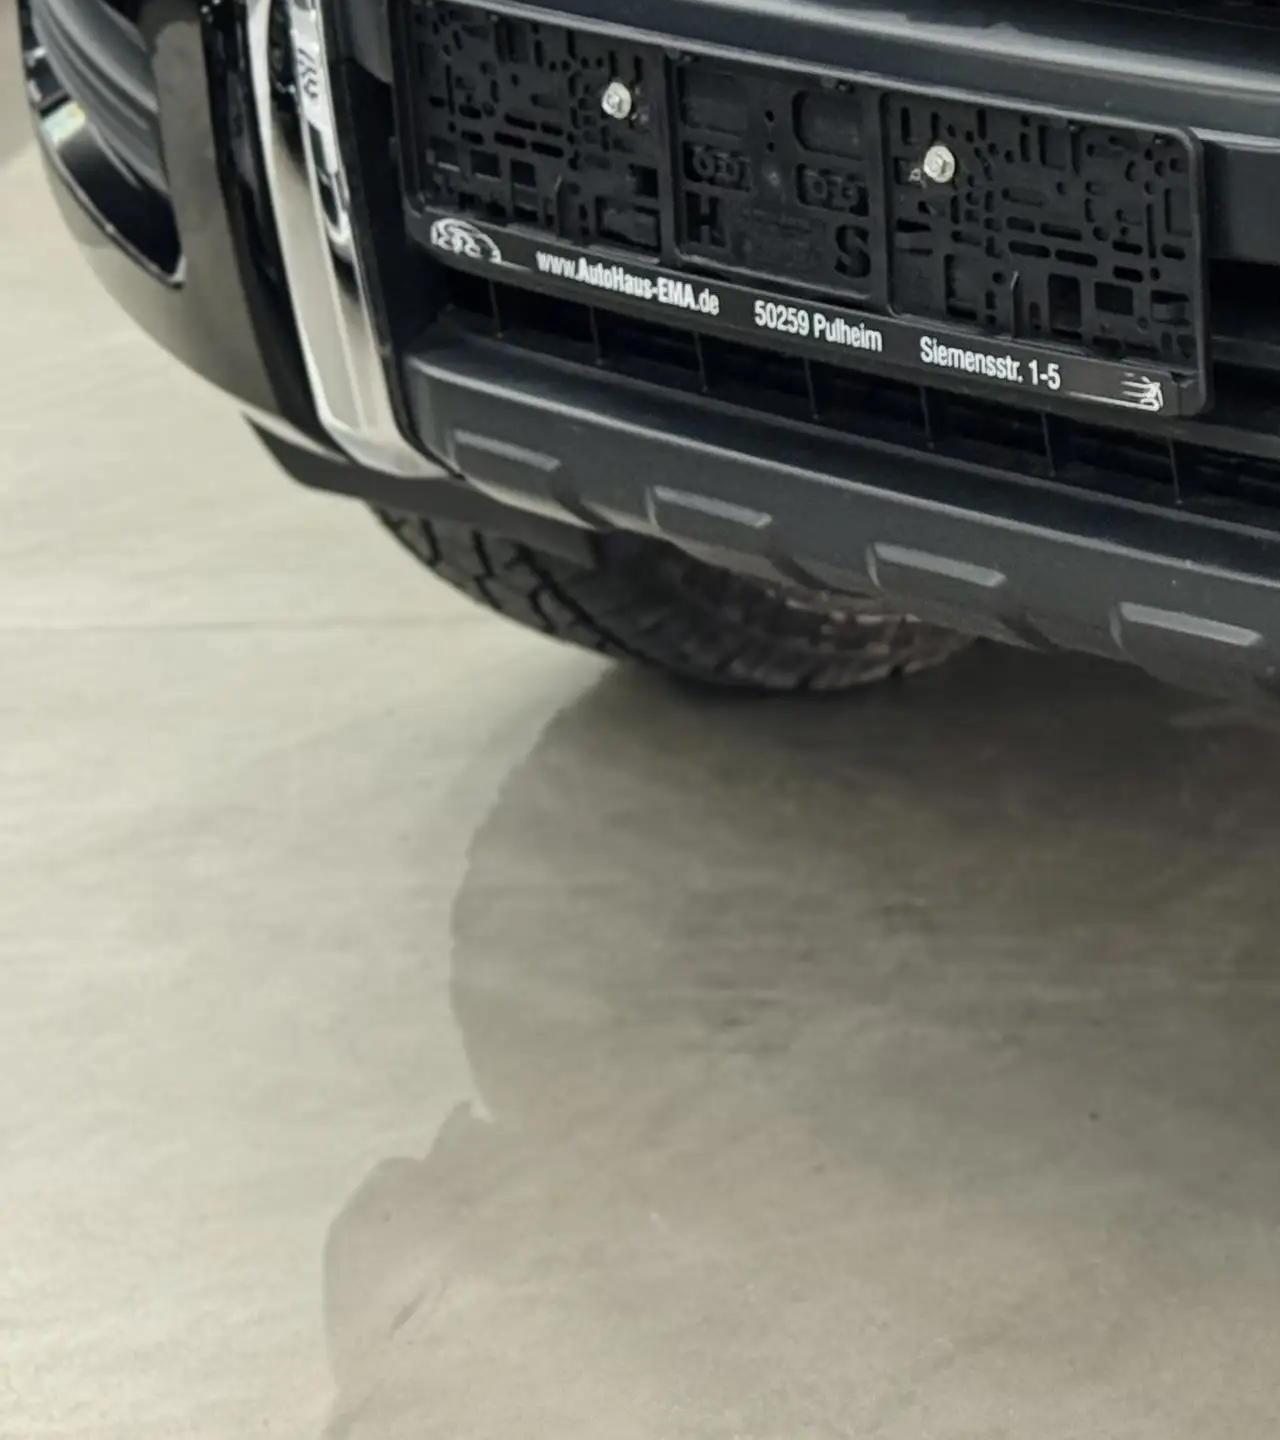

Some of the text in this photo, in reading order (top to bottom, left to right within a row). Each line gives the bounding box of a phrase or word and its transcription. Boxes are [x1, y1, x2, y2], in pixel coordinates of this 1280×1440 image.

[535, 251, 1061, 391] www.AutoHaus-EMA.de 50259 Pulheim Siemensstr. 1-5
